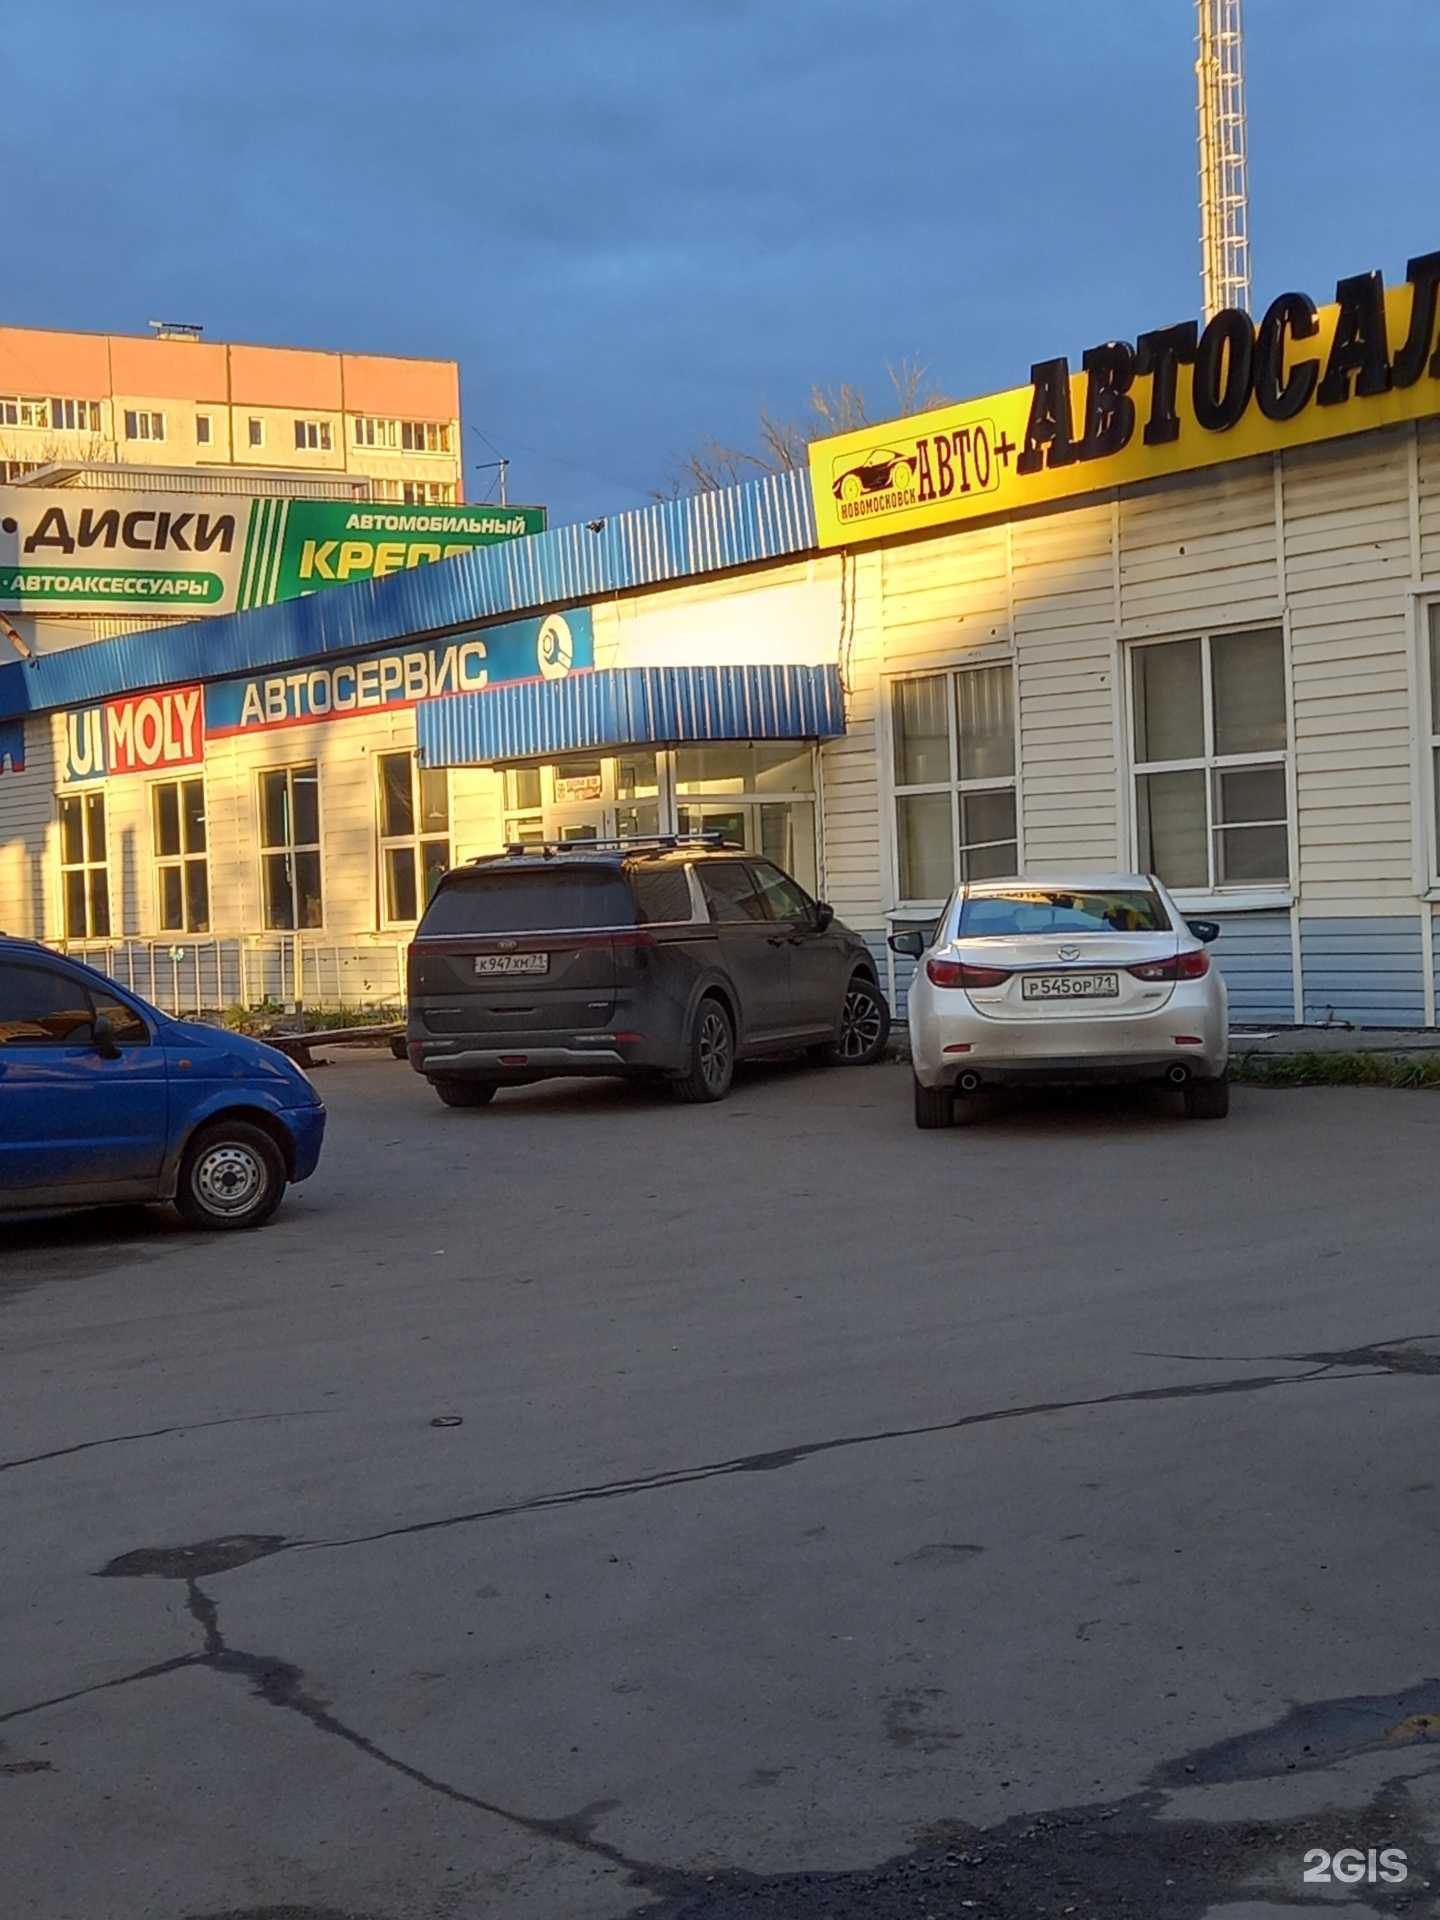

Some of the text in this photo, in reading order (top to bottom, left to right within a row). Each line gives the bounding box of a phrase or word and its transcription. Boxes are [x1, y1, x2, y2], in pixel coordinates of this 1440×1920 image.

[841, 488, 916, 519] НОВОМОСКОВСК
[24, 507, 236, 554] ДИСКИ
[346, 513, 526, 535] АВТОМОБИЛЬНЫЙ
[10, 575, 209, 596] АВТОАКСЕССУАРЫ
[239, 641, 488, 728] АВТОСЕРВИС
[106, 690, 201, 769] MOLY
